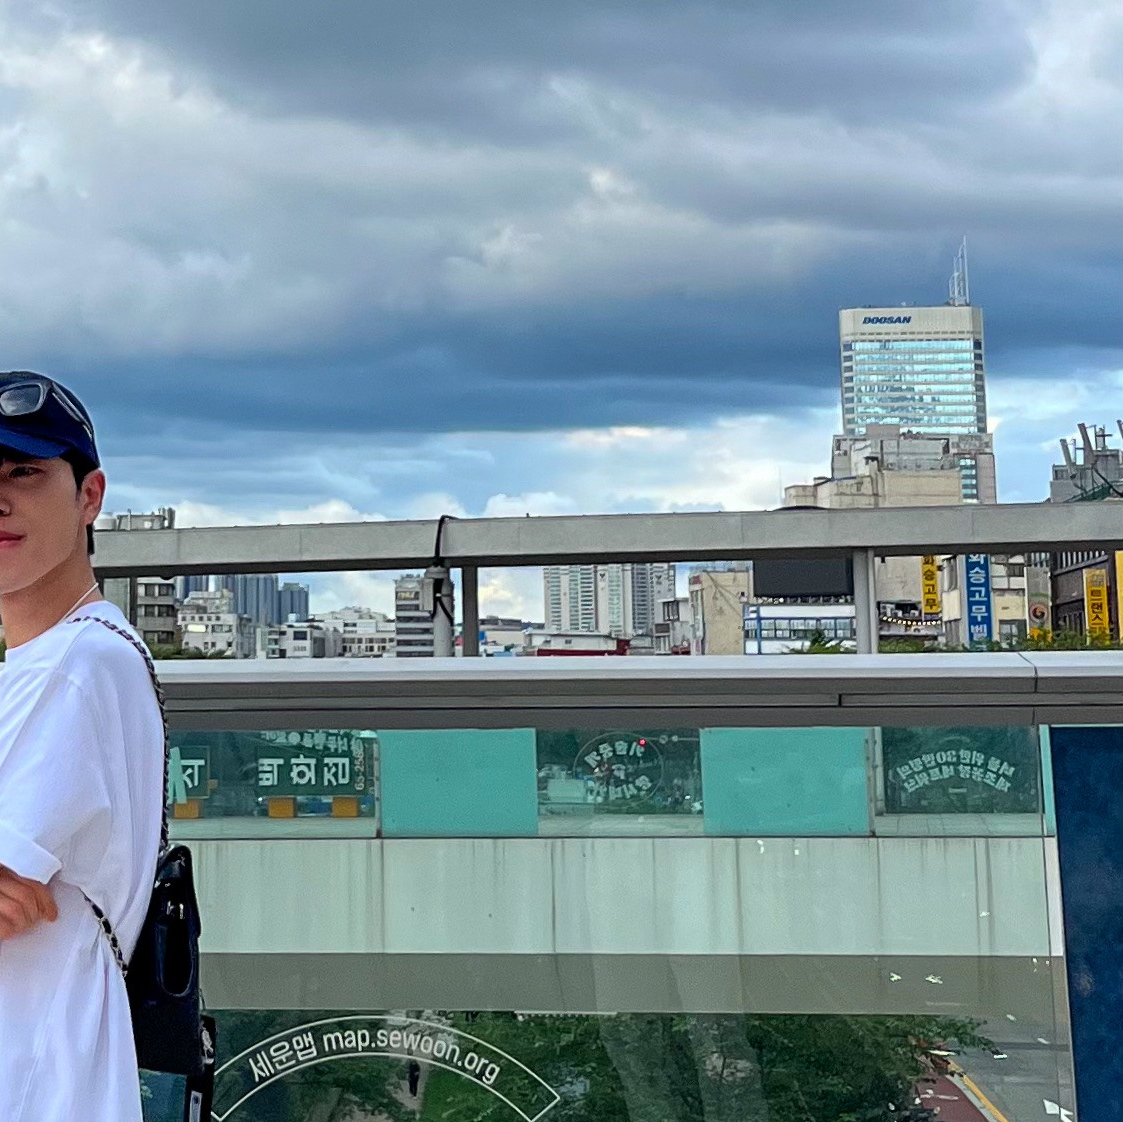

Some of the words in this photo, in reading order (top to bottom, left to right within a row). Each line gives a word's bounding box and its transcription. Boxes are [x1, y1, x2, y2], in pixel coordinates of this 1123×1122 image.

[862, 316, 912, 325] DOOSAN
[248, 1030, 318, 1083] 세운맵
[322, 1027, 502, 1085] map.sewoon.org
